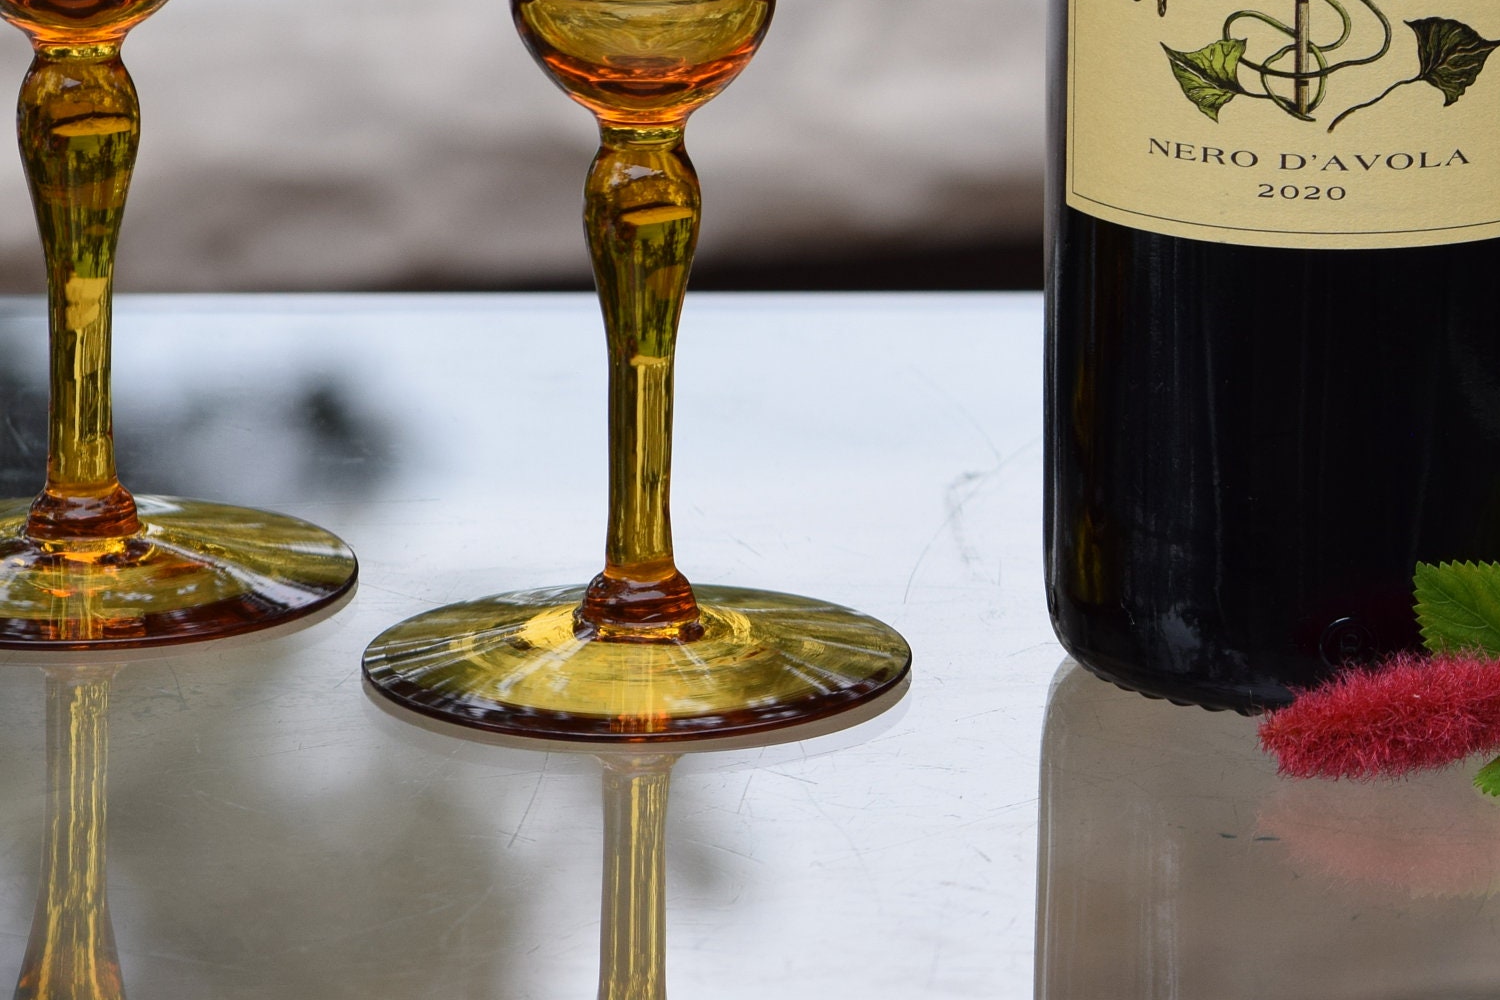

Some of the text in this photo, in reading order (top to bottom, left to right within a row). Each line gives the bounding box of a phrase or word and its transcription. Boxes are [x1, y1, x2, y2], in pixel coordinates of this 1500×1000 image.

[1148, 138, 1471, 171] NERO D’AVOLA
[1257, 184, 1347, 201] 2020
